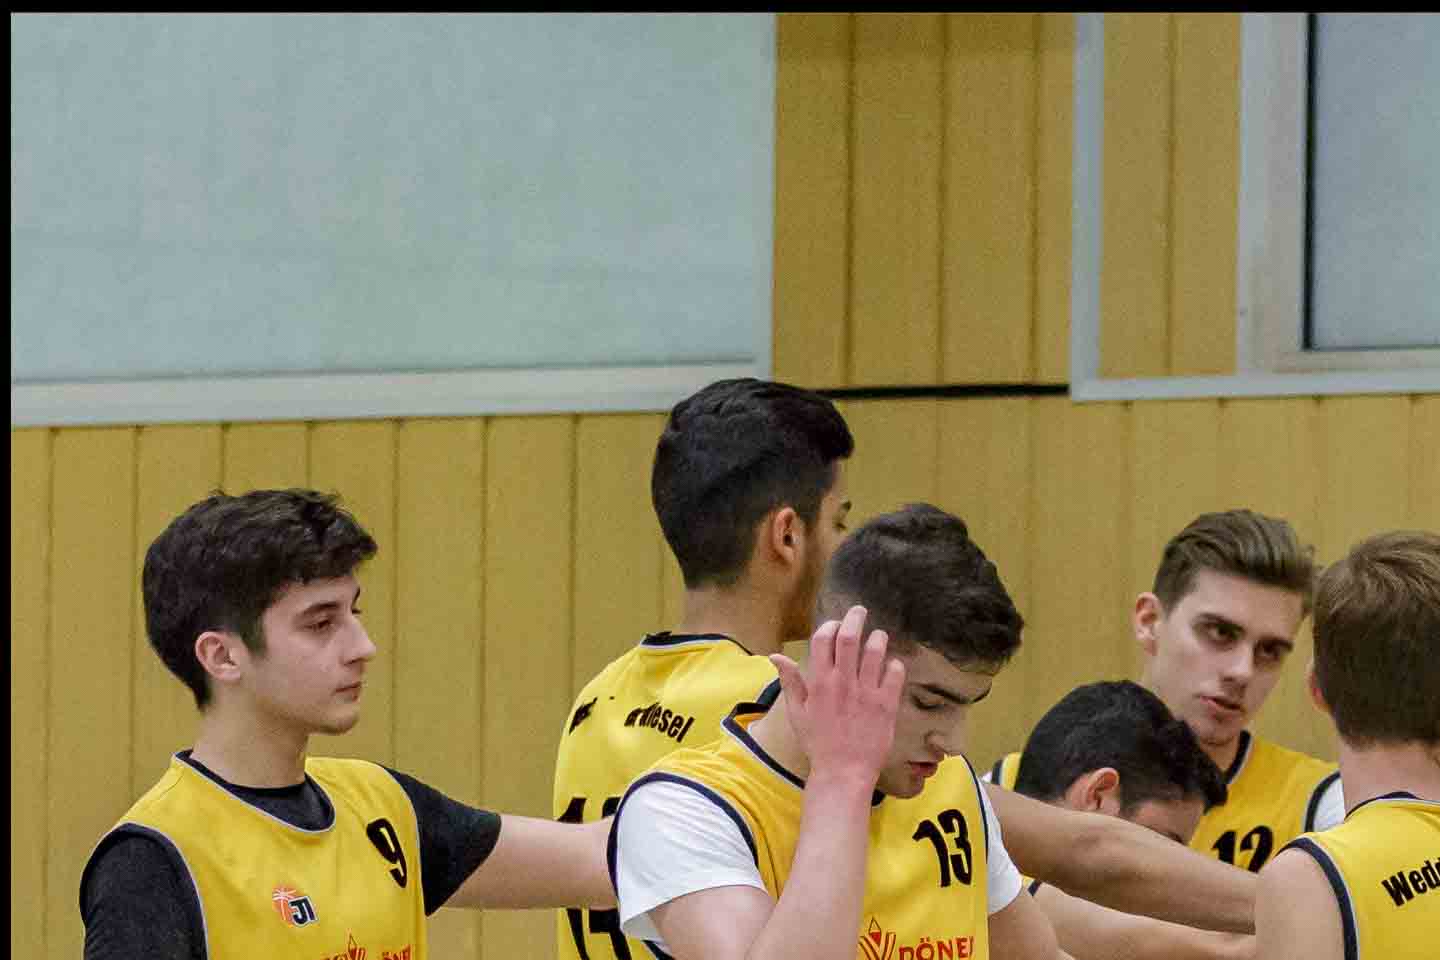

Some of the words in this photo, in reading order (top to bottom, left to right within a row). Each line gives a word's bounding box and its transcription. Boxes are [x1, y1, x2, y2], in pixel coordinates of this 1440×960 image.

[366, 817, 408, 888] 9
[912, 809, 973, 888] 13
[1211, 825, 1273, 874] 12
